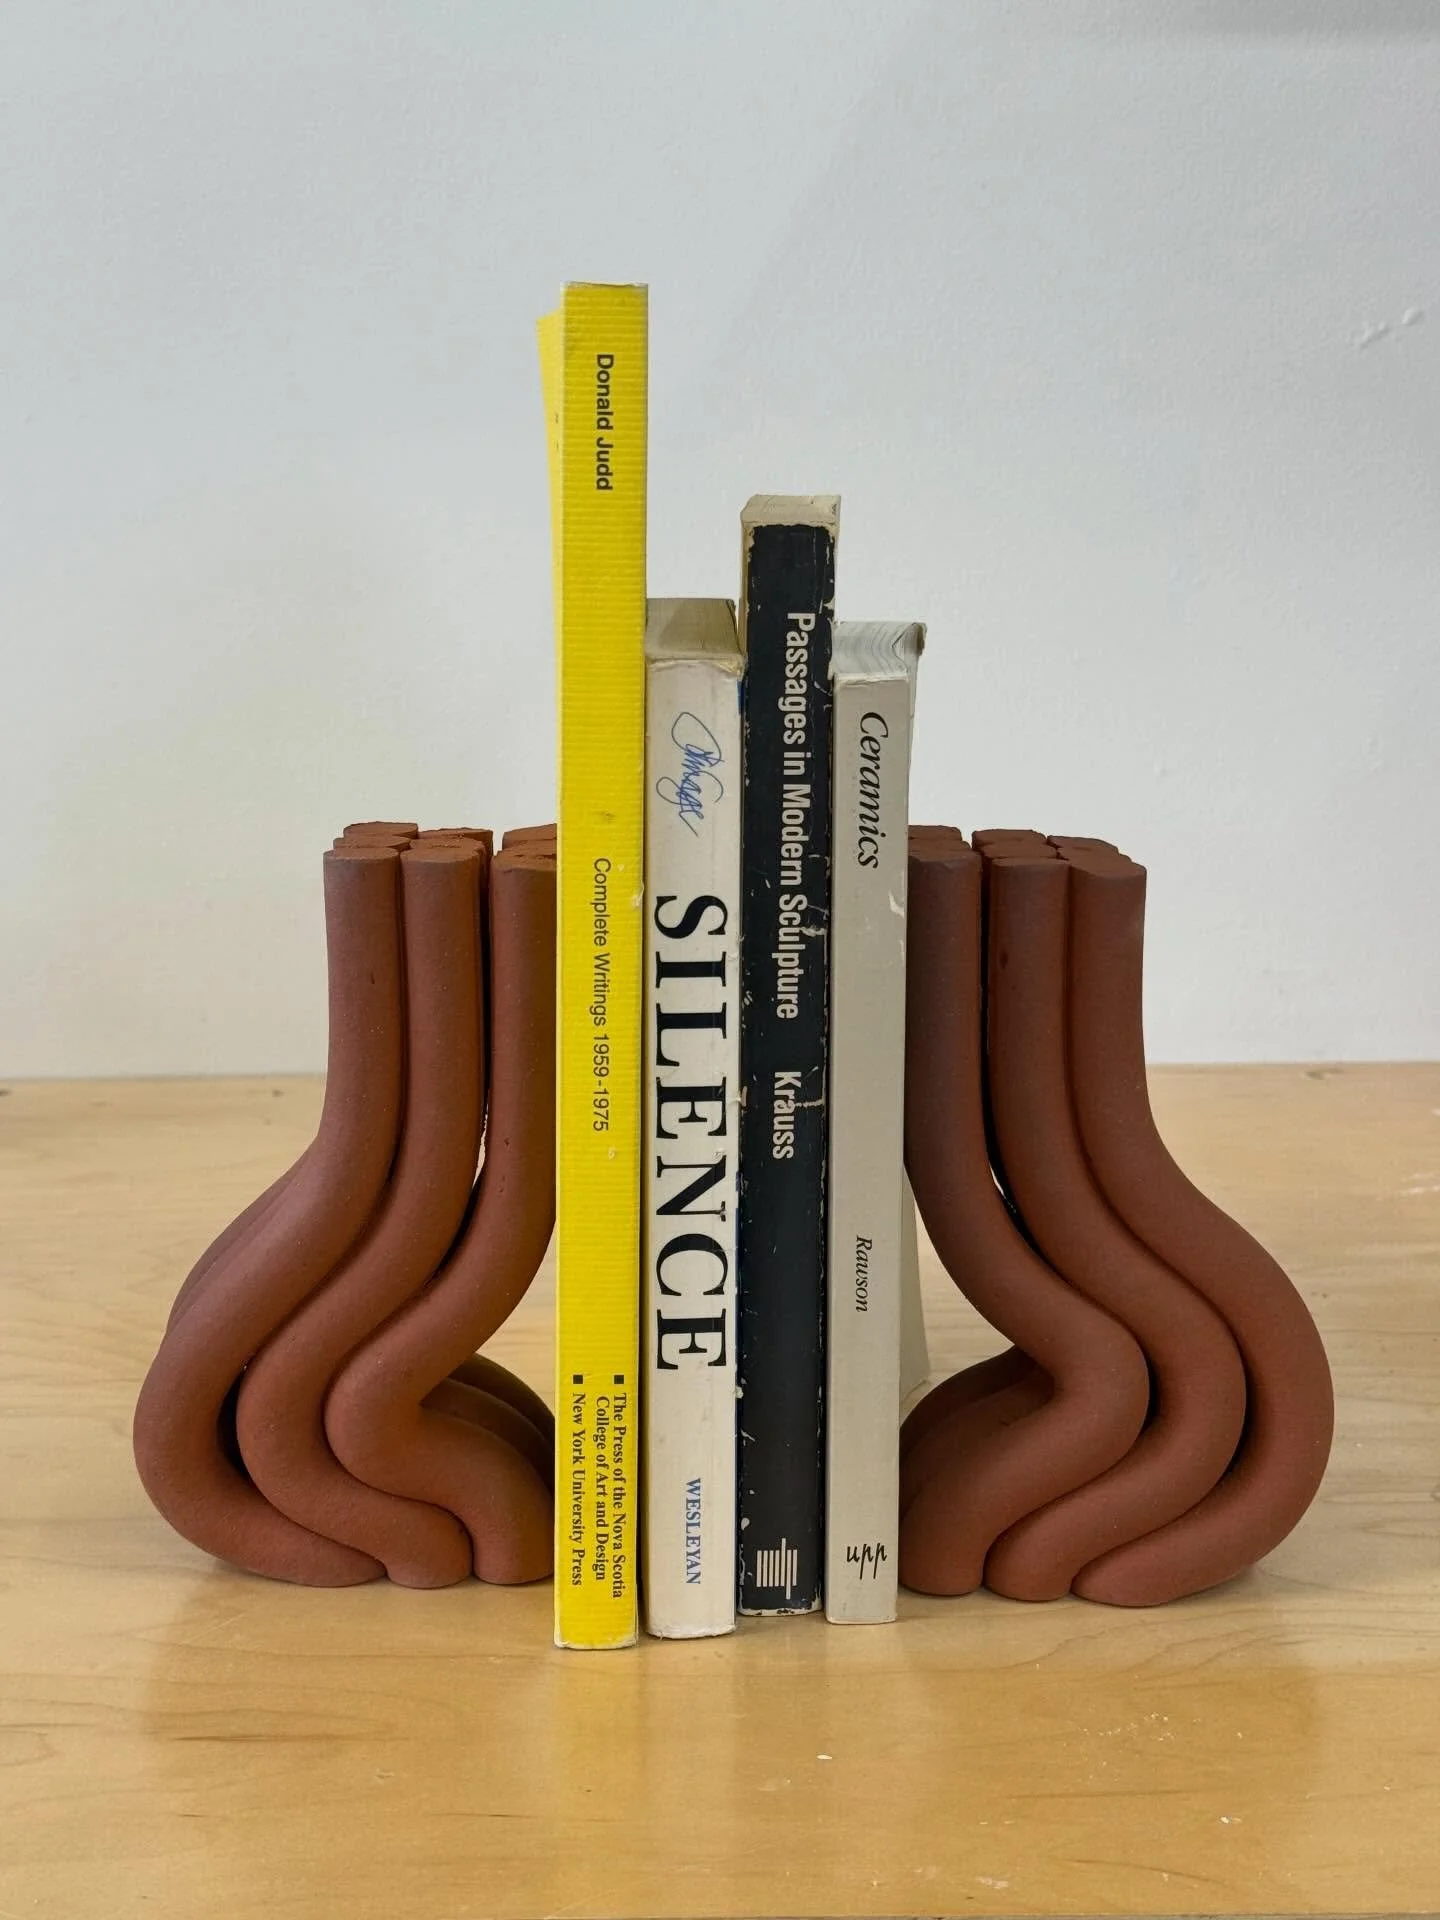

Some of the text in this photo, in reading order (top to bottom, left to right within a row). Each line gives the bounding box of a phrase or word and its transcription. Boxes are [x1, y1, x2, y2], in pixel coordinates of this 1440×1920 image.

[596, 354, 614, 490] Donald Judd
[772, 611, 816, 1019] Passages in Modern Sculpture
[857, 711, 888, 869] Ceramics
[593, 858, 612, 947] Complete
[590, 953, 610, 1027] Writings
[654, 895, 728, 1370] SILENCE
[772, 1071, 801, 1159] Krauss
[855, 1234, 873, 1313] Rawson
[569, 1393, 587, 1586] New York University Press
[591, 1396, 611, 1581] College of Art and Design
[611, 1392, 627, 1599] The Press of the Nova Scotia
[686, 1477, 701, 1585] WESLEYAN
